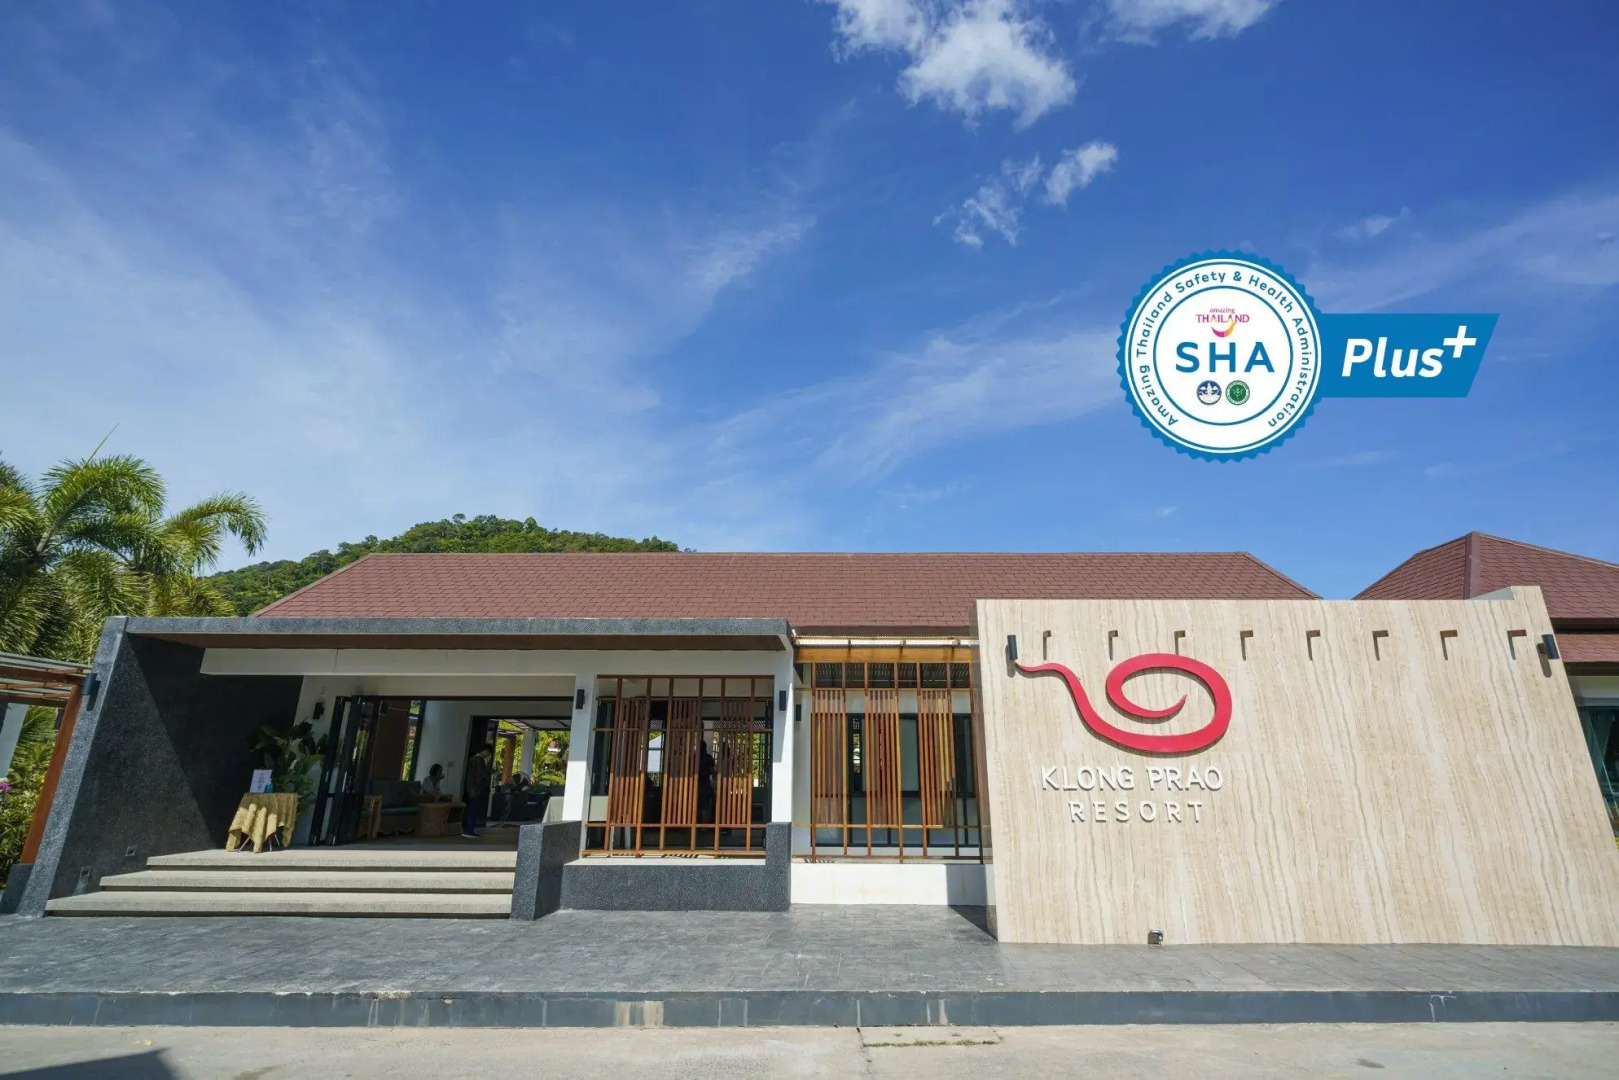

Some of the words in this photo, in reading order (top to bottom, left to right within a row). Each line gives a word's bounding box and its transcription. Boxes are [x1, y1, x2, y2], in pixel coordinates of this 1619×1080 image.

[1041, 766, 1135, 791] KLONG
[1146, 766, 1224, 791] PRAO
[1068, 801, 1203, 823] RESORT
